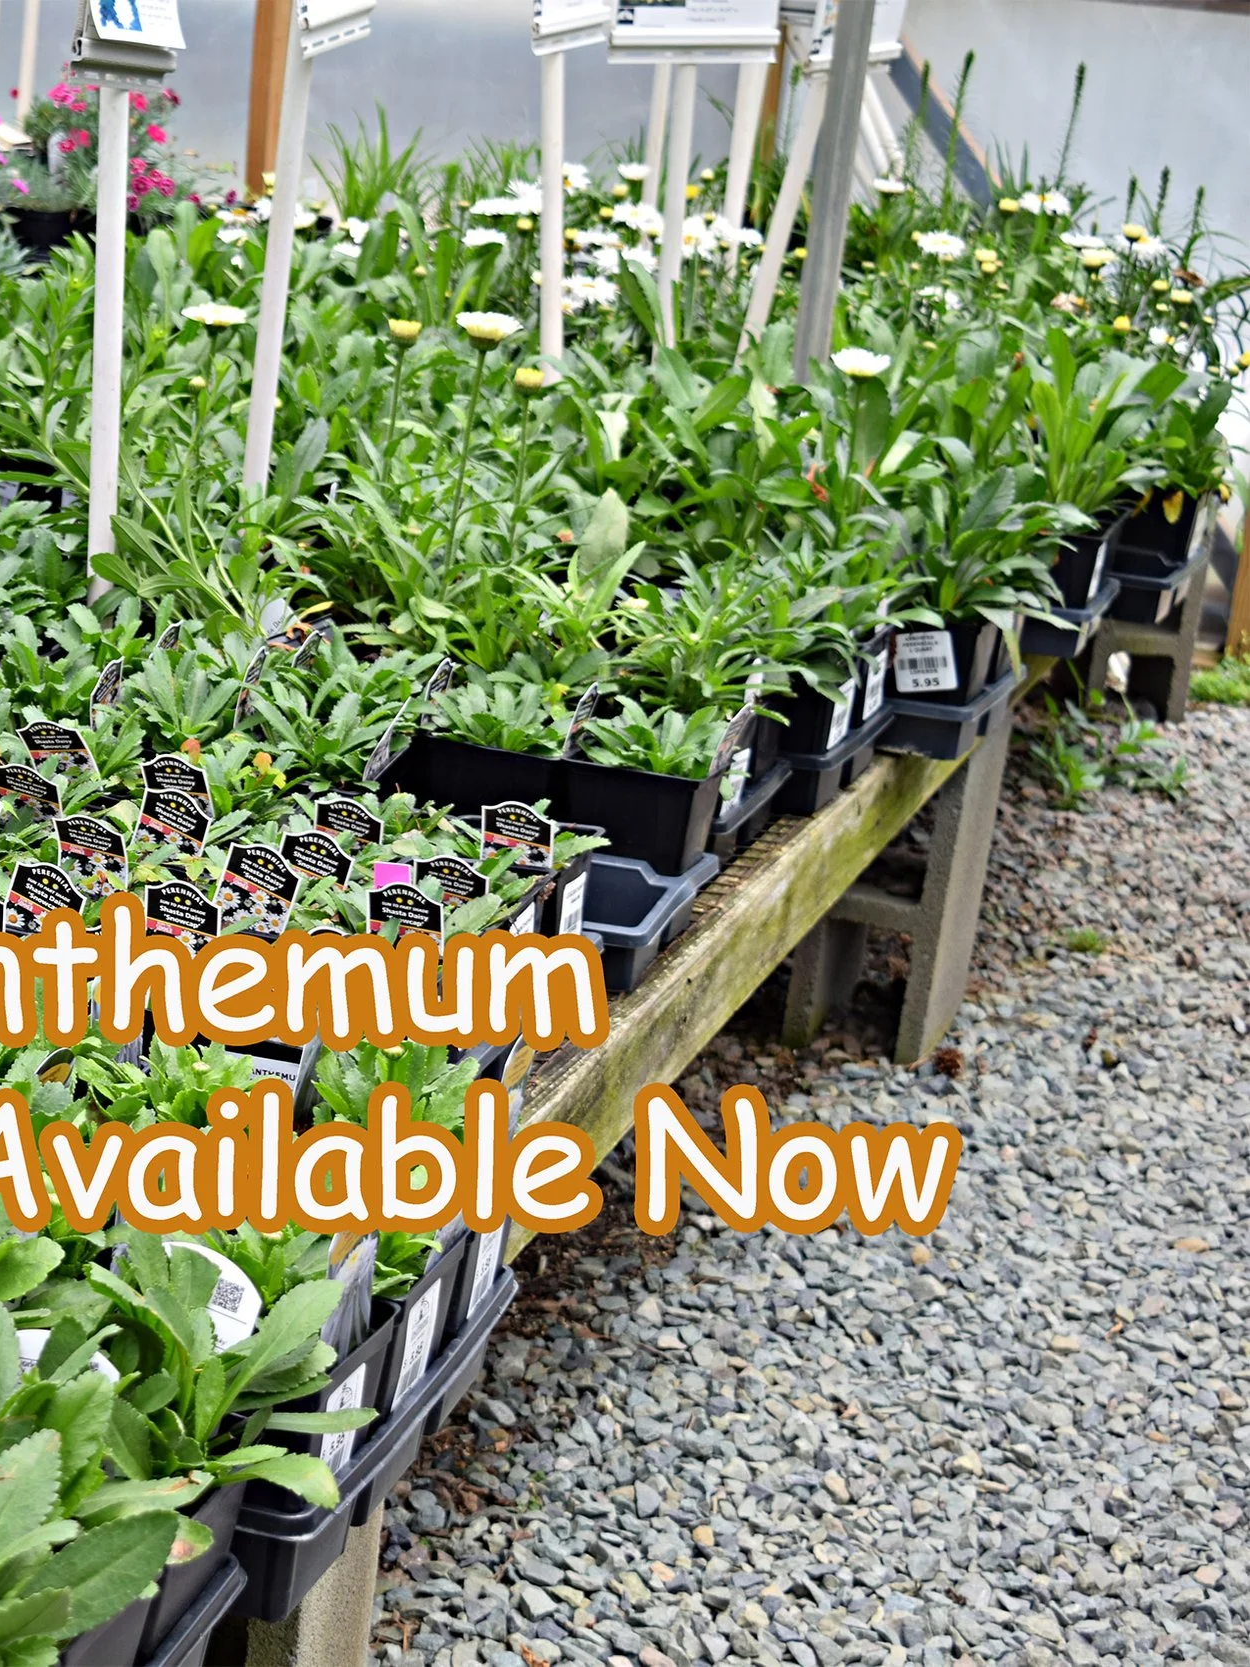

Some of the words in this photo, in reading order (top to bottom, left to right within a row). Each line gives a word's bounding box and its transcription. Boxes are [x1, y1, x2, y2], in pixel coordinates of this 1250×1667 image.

[912, 678, 940, 687] 5.95
[299, 836, 340, 857] PERENNIAL
[246, 849, 287, 873] PERENNIAL
[32, 869, 71, 893] PERENNIAL
[161, 887, 204, 906] PERENNIAL
[159, 905, 184, 917] Shasta
[185, 913, 206, 924] Daisy
